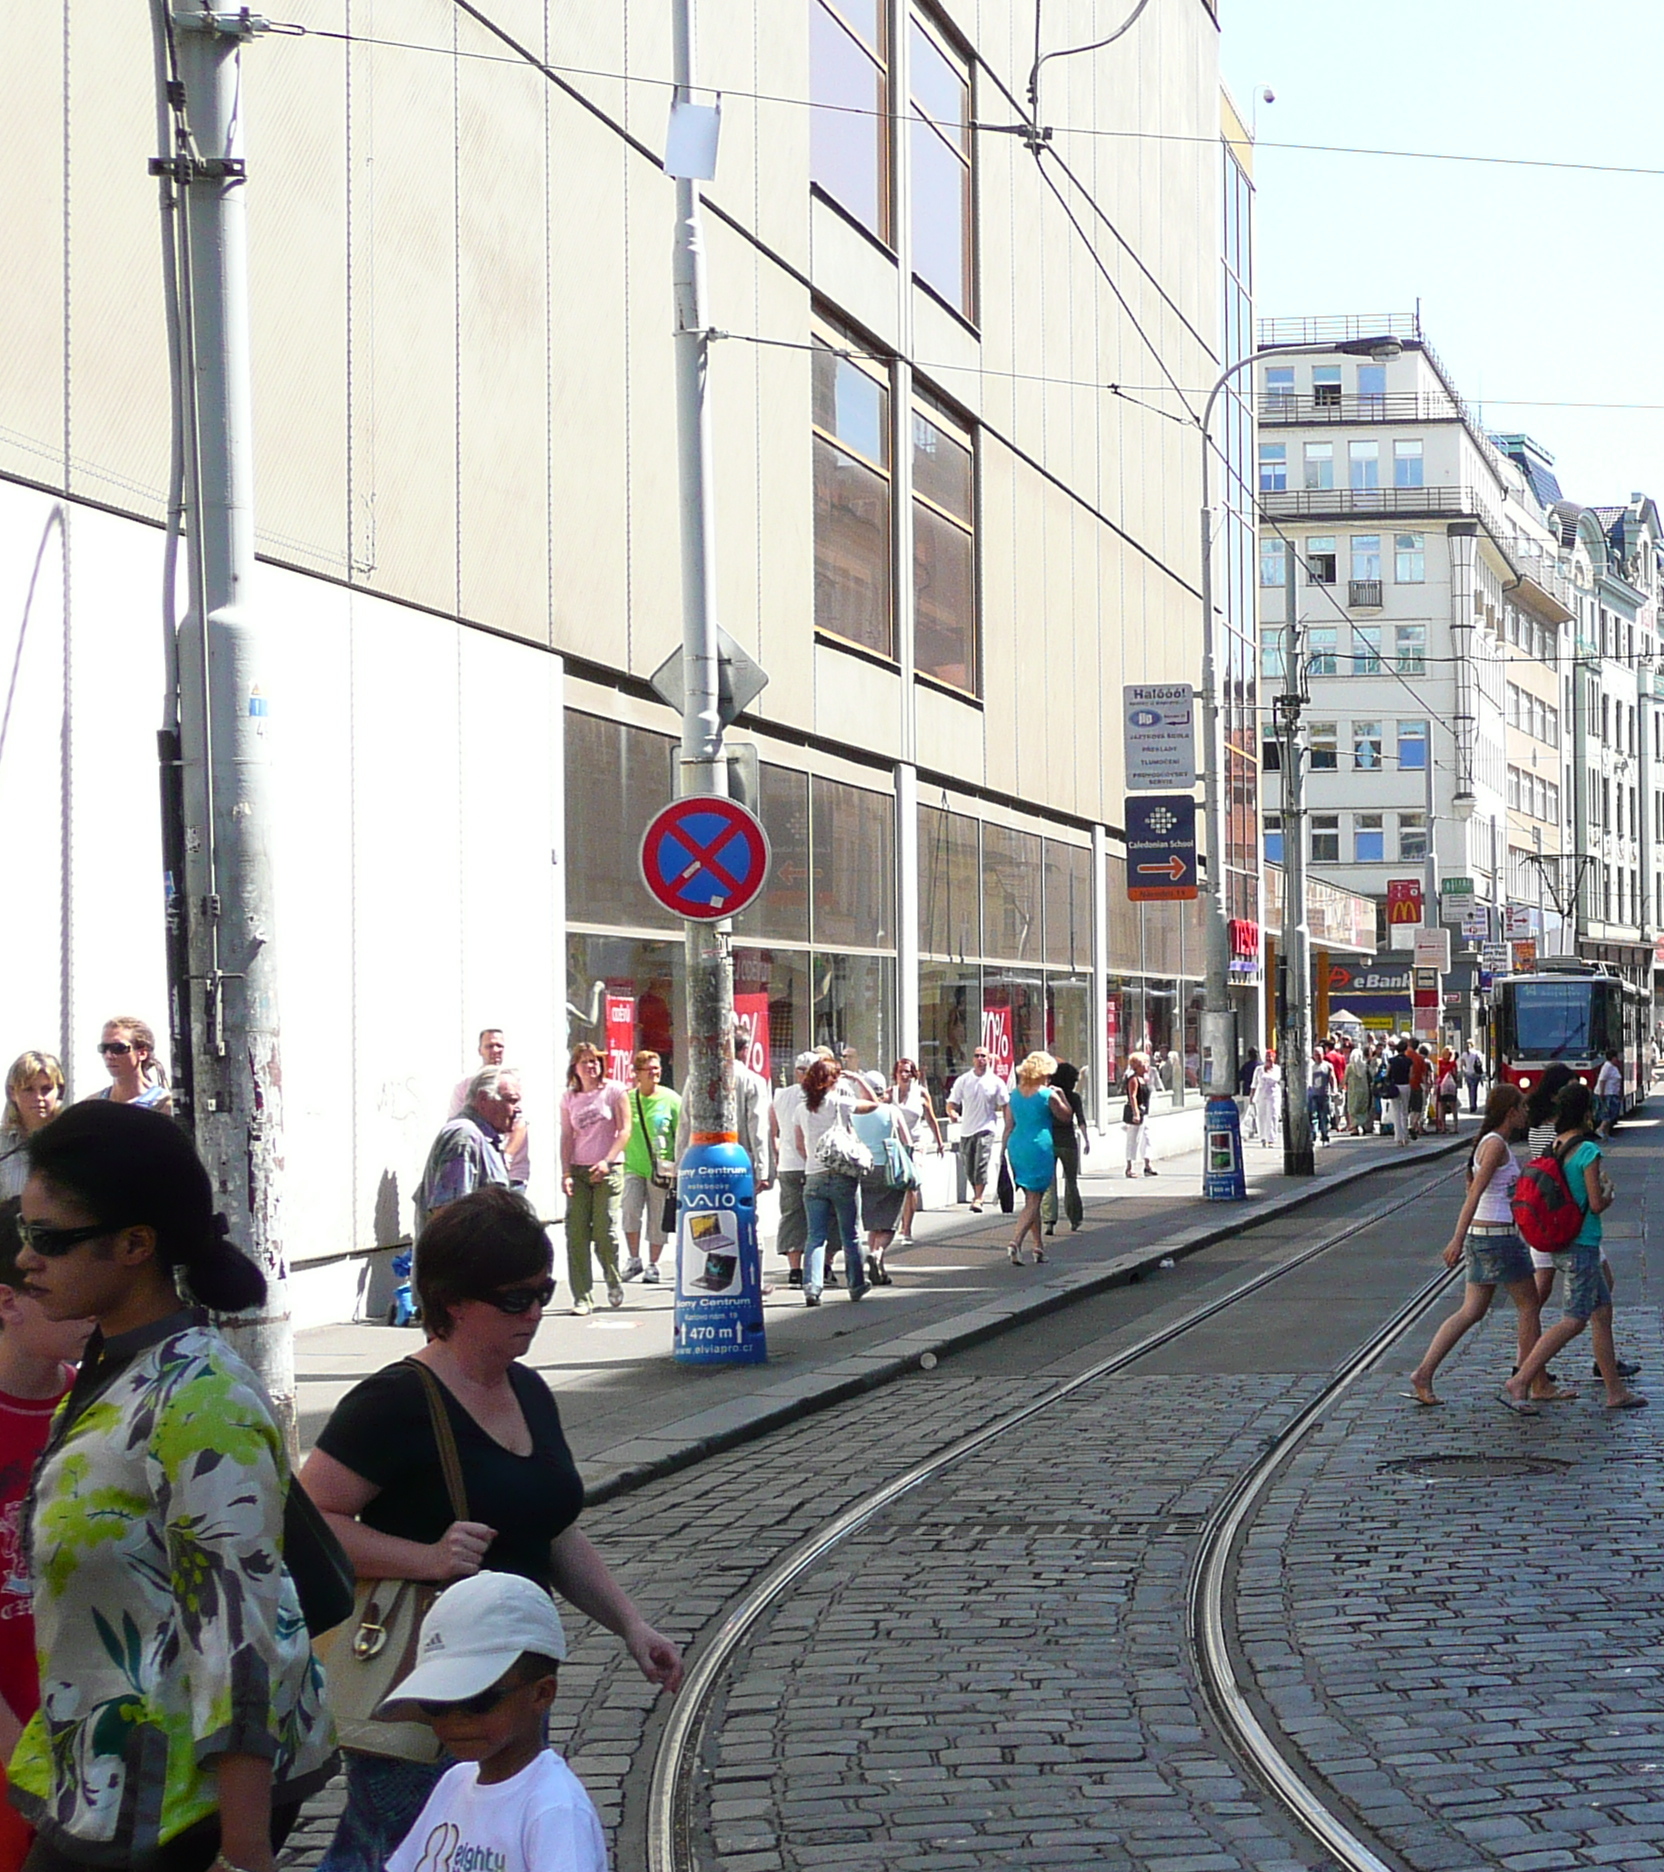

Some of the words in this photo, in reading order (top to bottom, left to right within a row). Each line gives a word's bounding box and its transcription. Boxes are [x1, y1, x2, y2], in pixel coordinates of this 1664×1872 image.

[1133, 688, 1186, 699] Halóóó!
[1128, 840, 1168, 849] Caledonian
[1169, 840, 1194, 848] School
[698, 1166, 747, 1175] Centrum
[683, 1193, 736, 1207] VAIO
[700, 1298, 751, 1307] Centrum
[690, 1326, 715, 1340] 470
[719, 1328, 733, 1338] m
